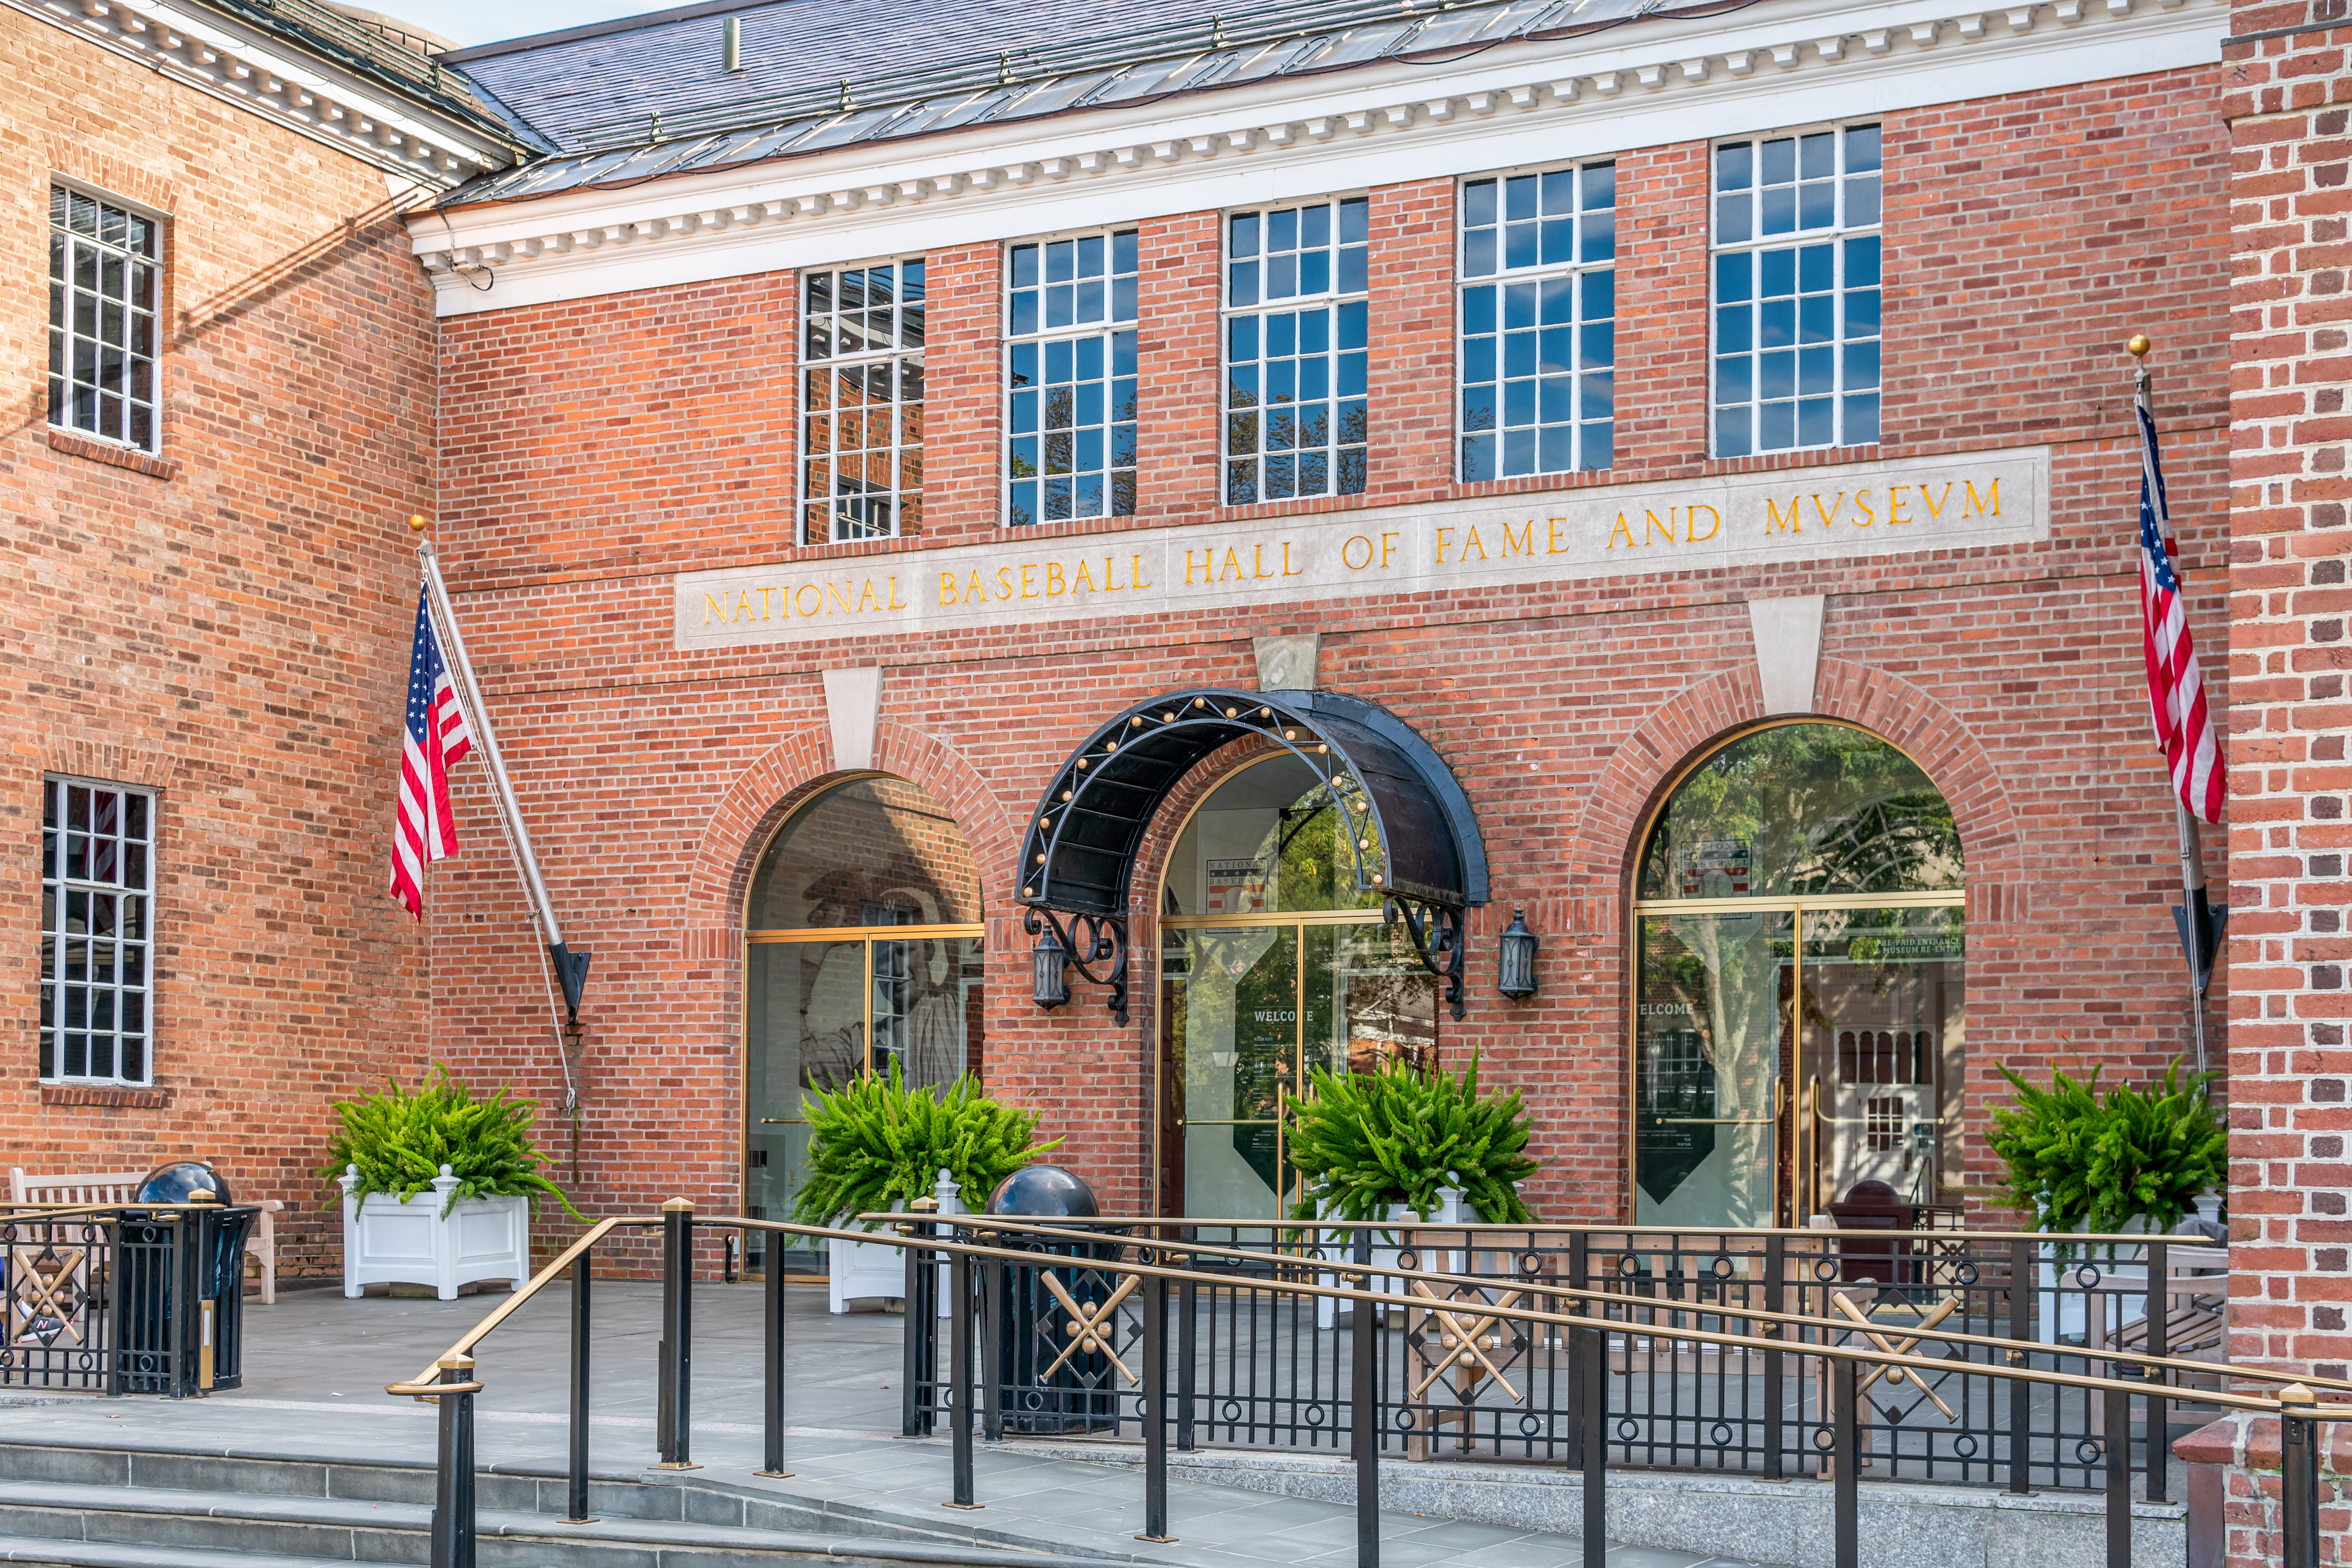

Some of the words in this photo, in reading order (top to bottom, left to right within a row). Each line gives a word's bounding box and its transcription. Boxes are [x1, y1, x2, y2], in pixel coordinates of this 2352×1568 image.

[704, 577, 907, 624] NATIONAL
[939, 554, 1152, 606] BASEBALL
[1184, 542, 1303, 585] HALL
[1342, 532, 1400, 570] OF
[1435, 517, 1569, 564] FAME
[1606, 505, 1720, 549] AND
[1685, 859, 1749, 869] BASEBALL
[1209, 877, 1265, 885] BASEBALL
[1638, 1003, 1694, 1015] ELCOME
[1254, 1011, 1313, 1022] WELCOE
[36, 1320, 48, 1329] N
